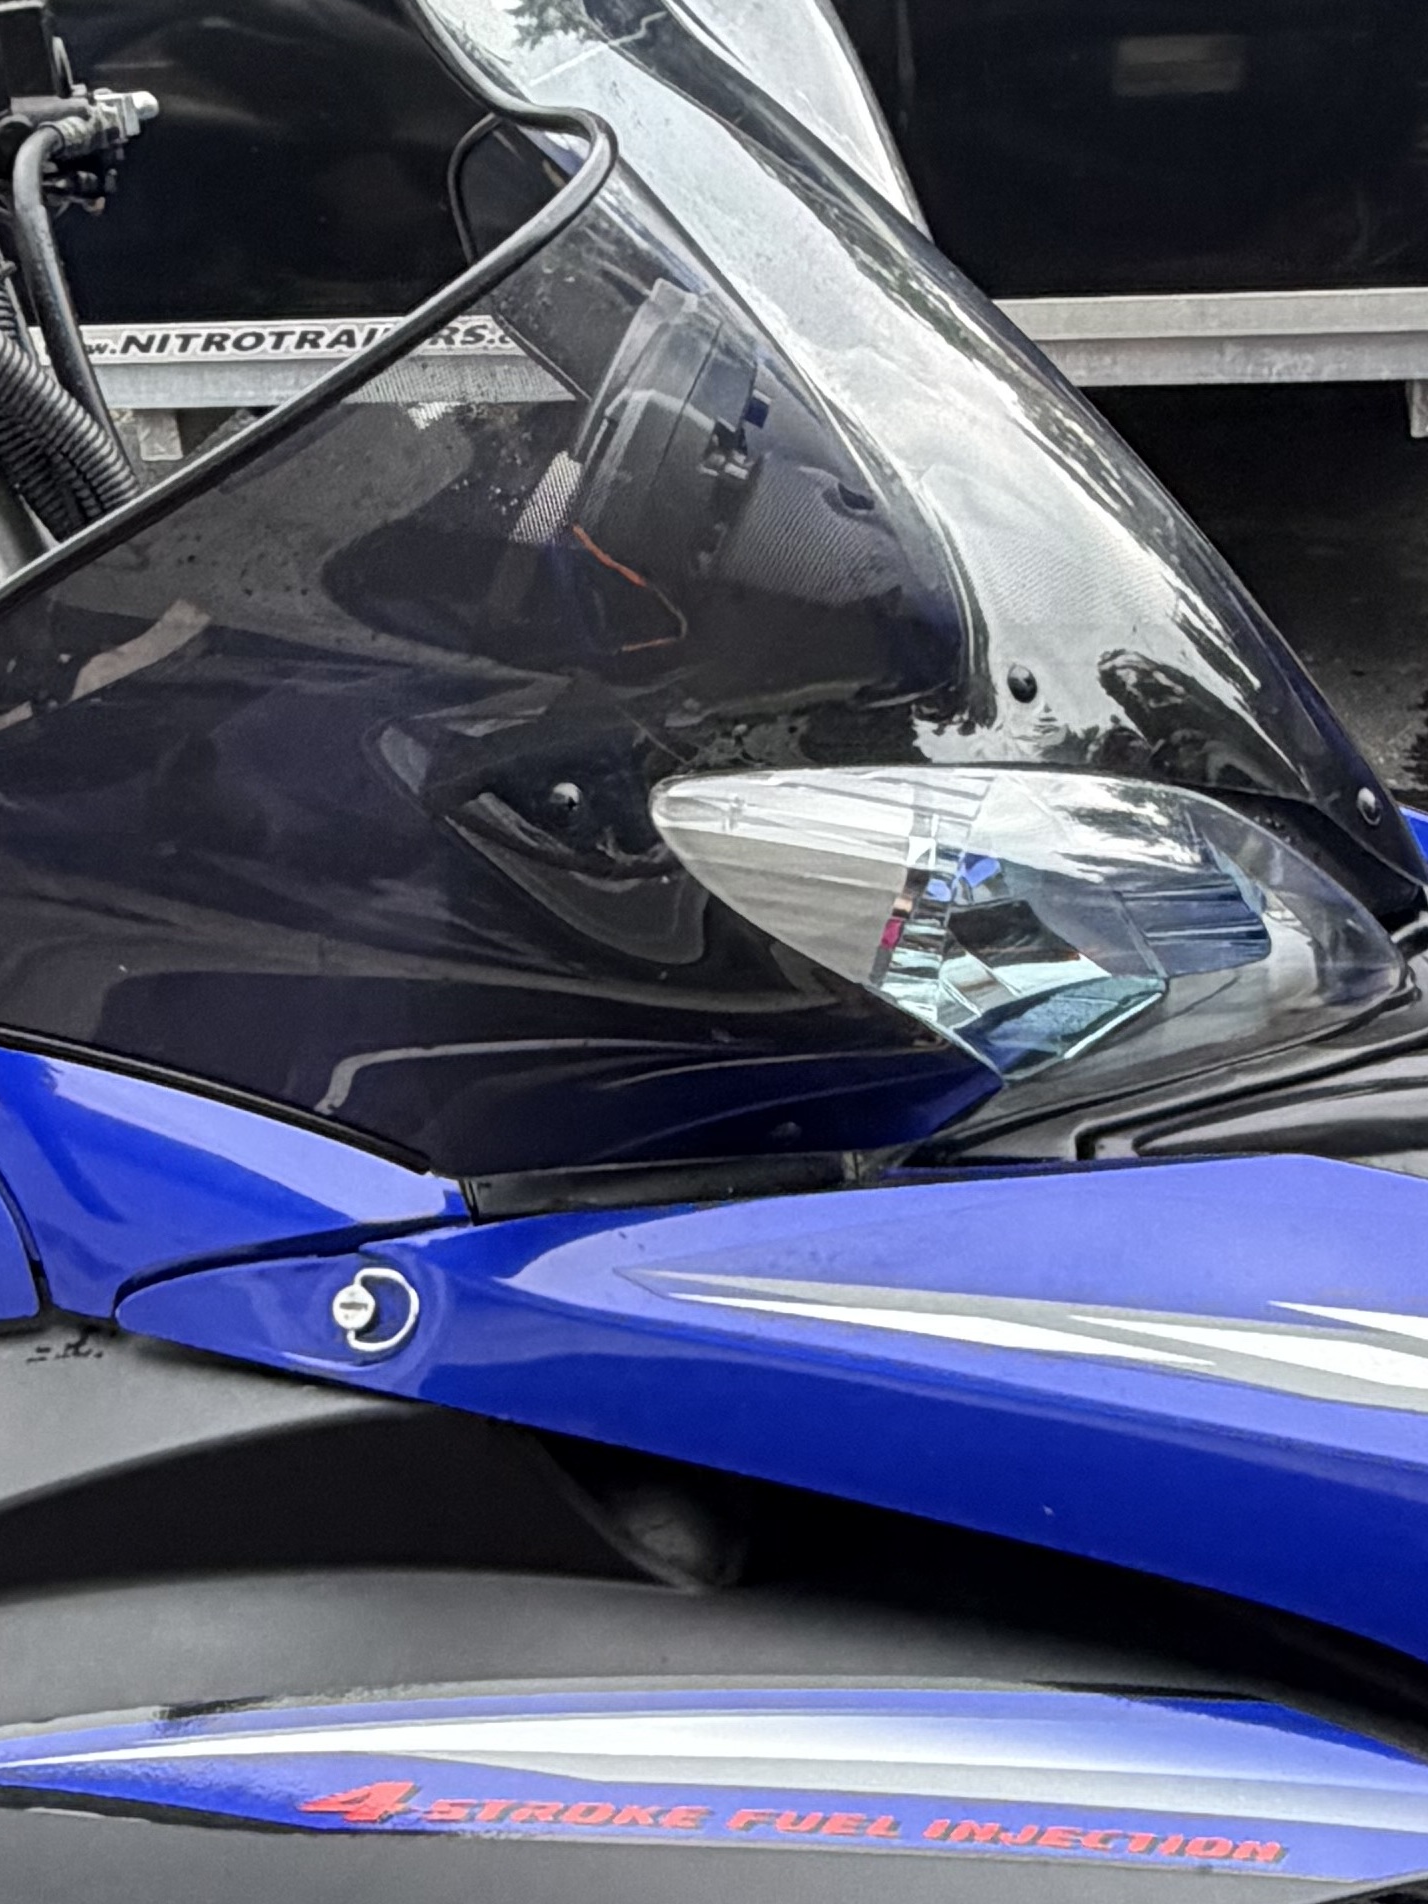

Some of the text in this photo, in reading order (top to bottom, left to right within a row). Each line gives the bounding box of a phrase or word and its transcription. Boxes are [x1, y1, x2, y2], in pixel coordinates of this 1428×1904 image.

[296, 1781, 1290, 1863] 4 STROKE FUEL INJECTION
